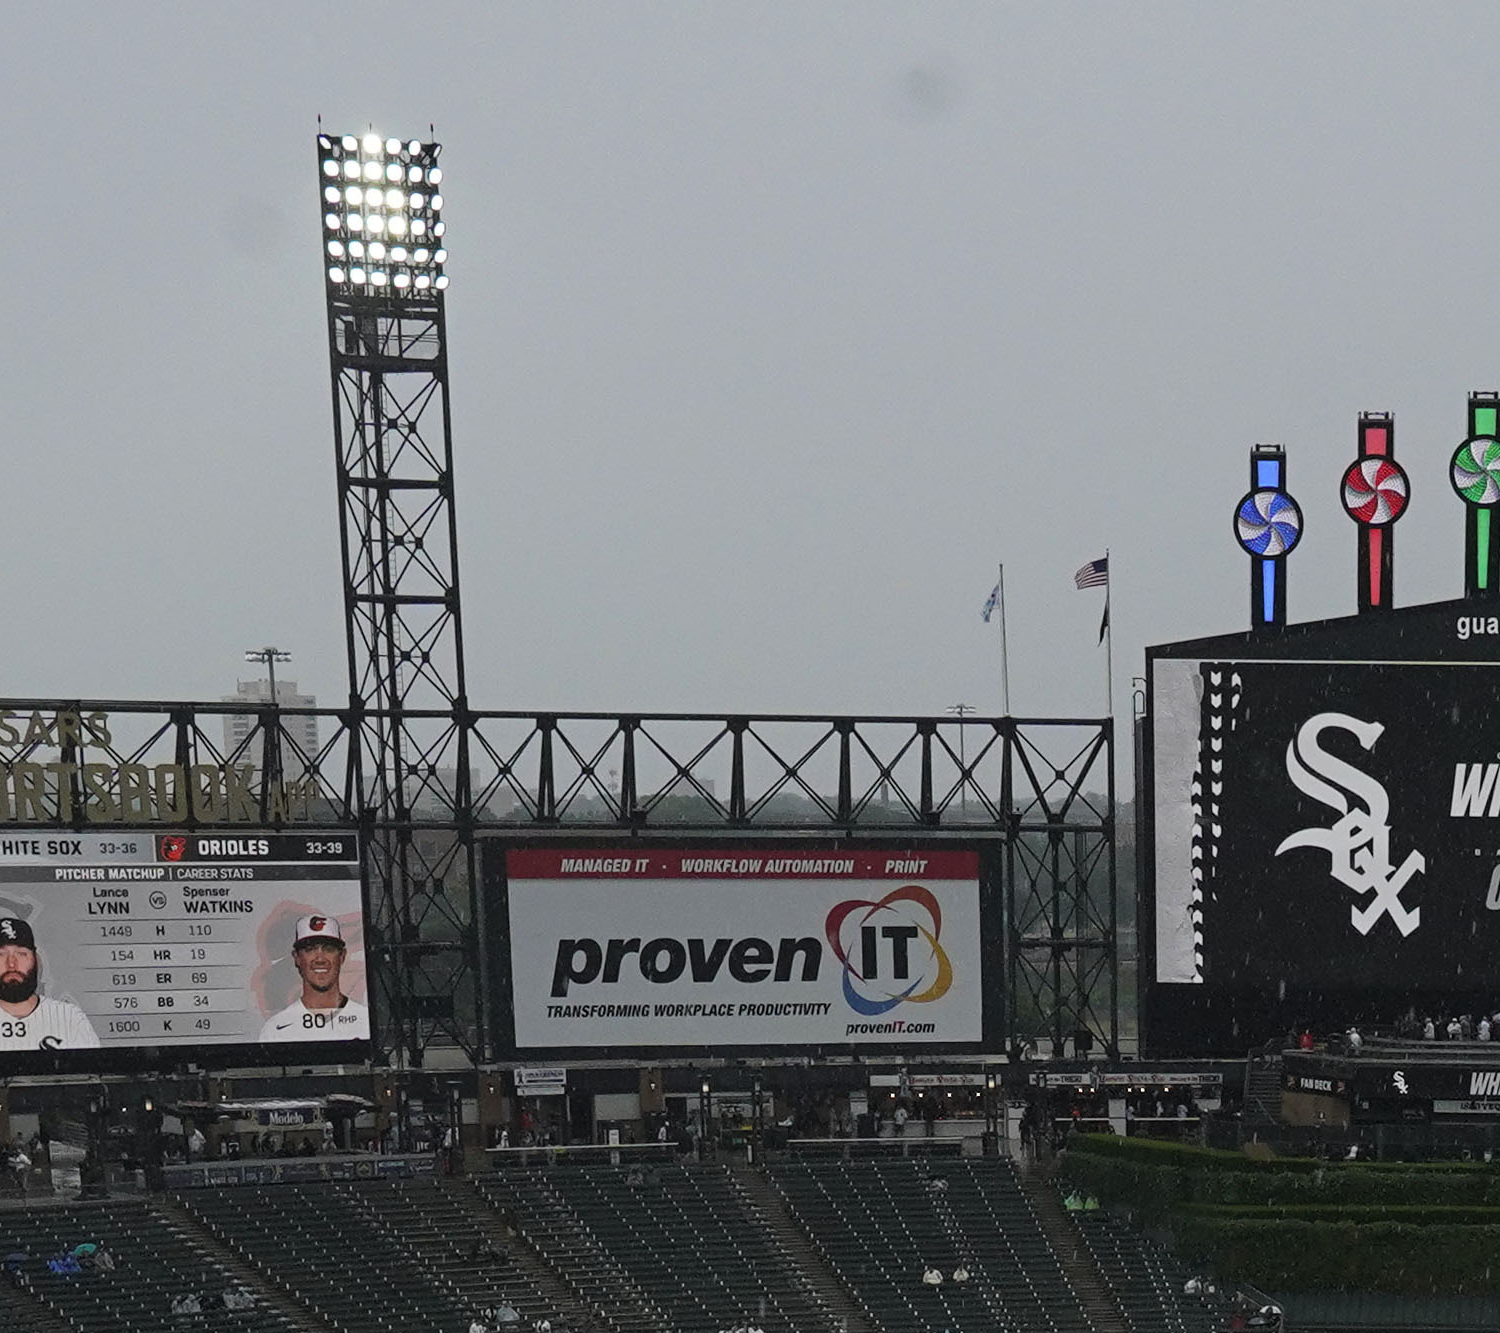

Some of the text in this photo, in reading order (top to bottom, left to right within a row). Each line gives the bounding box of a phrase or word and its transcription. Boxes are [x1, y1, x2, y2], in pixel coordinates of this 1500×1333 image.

[47, 839, 83, 856] SOX
[100, 843, 137, 854] 33-36
[197, 840, 343, 857] ORIOLES 33-39
[560, 858, 928, 874] MANAGED IT WORKFLOW AUTOMATION PRINT
[55, 867, 253, 881] PITCHER MATCHUP CAREER STATS
[88, 901, 130, 915] LYNN
[184, 899, 253, 915] WATKINS
[101, 925, 212, 938] 1449 H 110
[110, 949, 134, 962] 154
[153, 949, 171, 961] HR
[550, 925, 918, 997] proven IT
[112, 973, 136, 986] 619
[156, 973, 172, 985] ER
[114, 995, 209, 1009] 576 BB 34
[546, 1002, 831, 1019] TRANSFORMING WORKPLACE PRODUCTIVITY
[108, 1018, 211, 1033] 1600 K 49
[845, 1020, 935, 1036] provenIT.com
